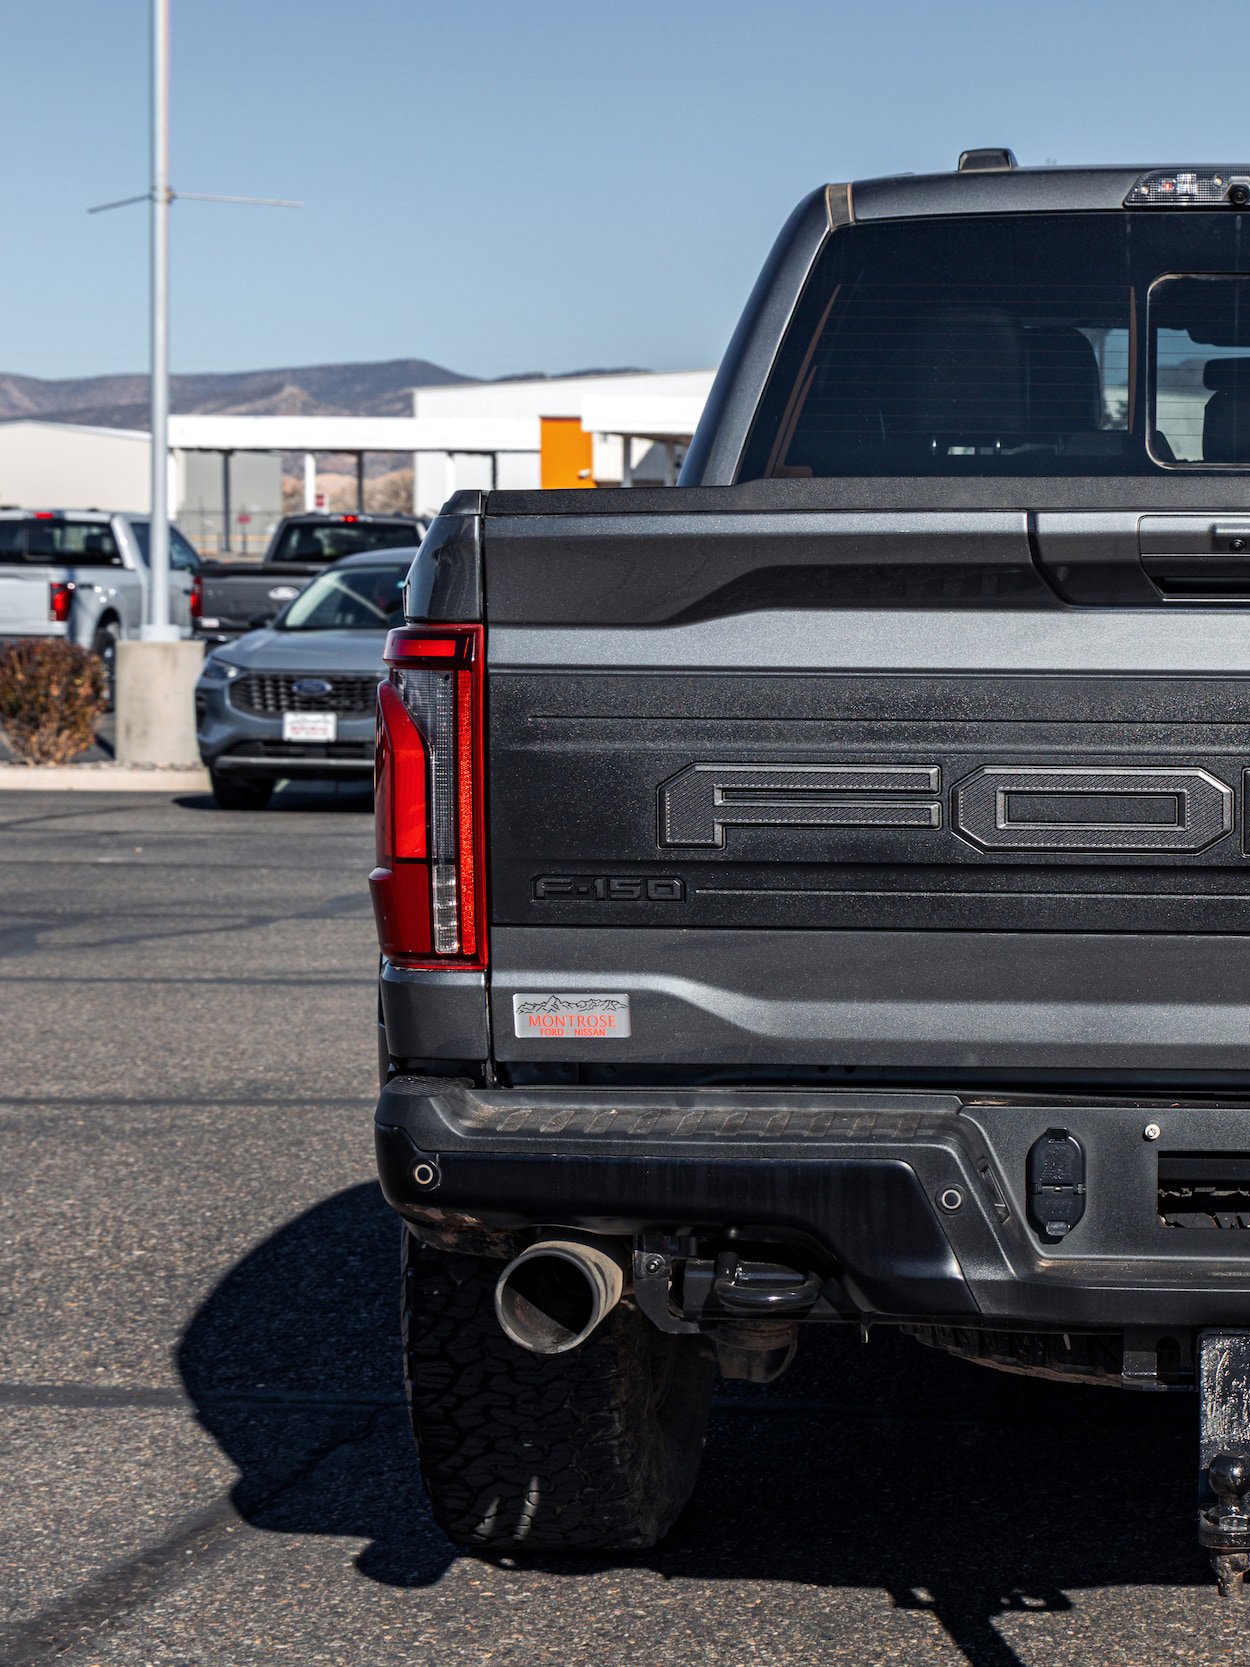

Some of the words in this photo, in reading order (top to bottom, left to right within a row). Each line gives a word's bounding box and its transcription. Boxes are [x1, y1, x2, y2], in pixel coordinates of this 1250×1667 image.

[533, 875, 685, 901] F-150
[529, 1015, 617, 1028] MONTROSE
[540, 1028, 564, 1036] FORD
[574, 1028, 606, 1036] NISSAN
